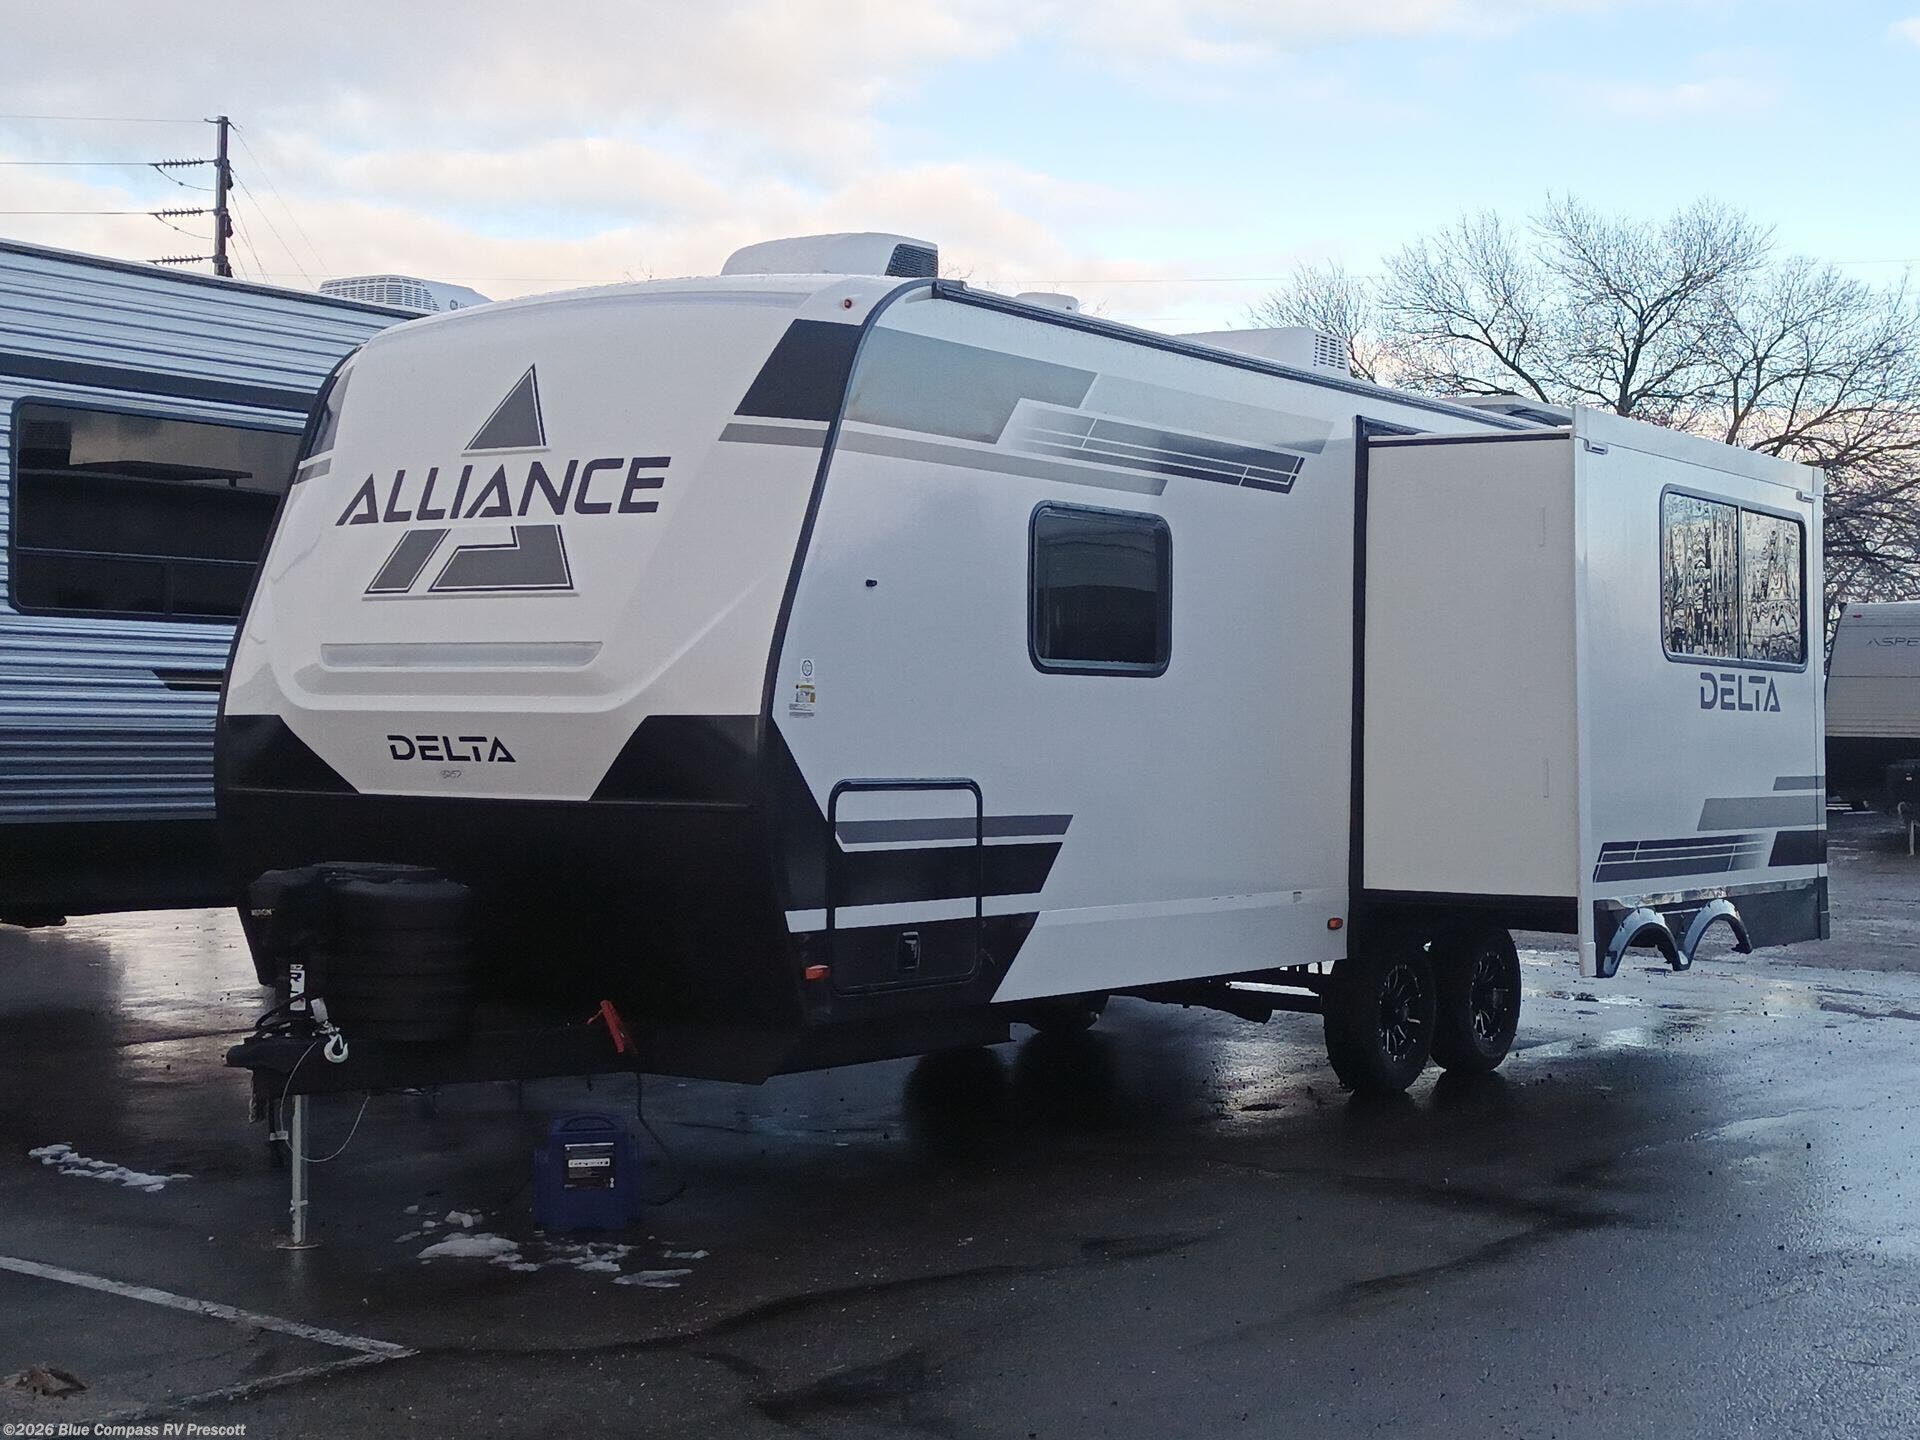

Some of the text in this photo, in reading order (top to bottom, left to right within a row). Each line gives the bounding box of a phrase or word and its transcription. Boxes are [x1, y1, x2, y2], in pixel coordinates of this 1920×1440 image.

[335, 456, 671, 526] ALLIANCE
[1700, 672, 1781, 712] DELTA
[387, 735, 516, 762] DELTA
